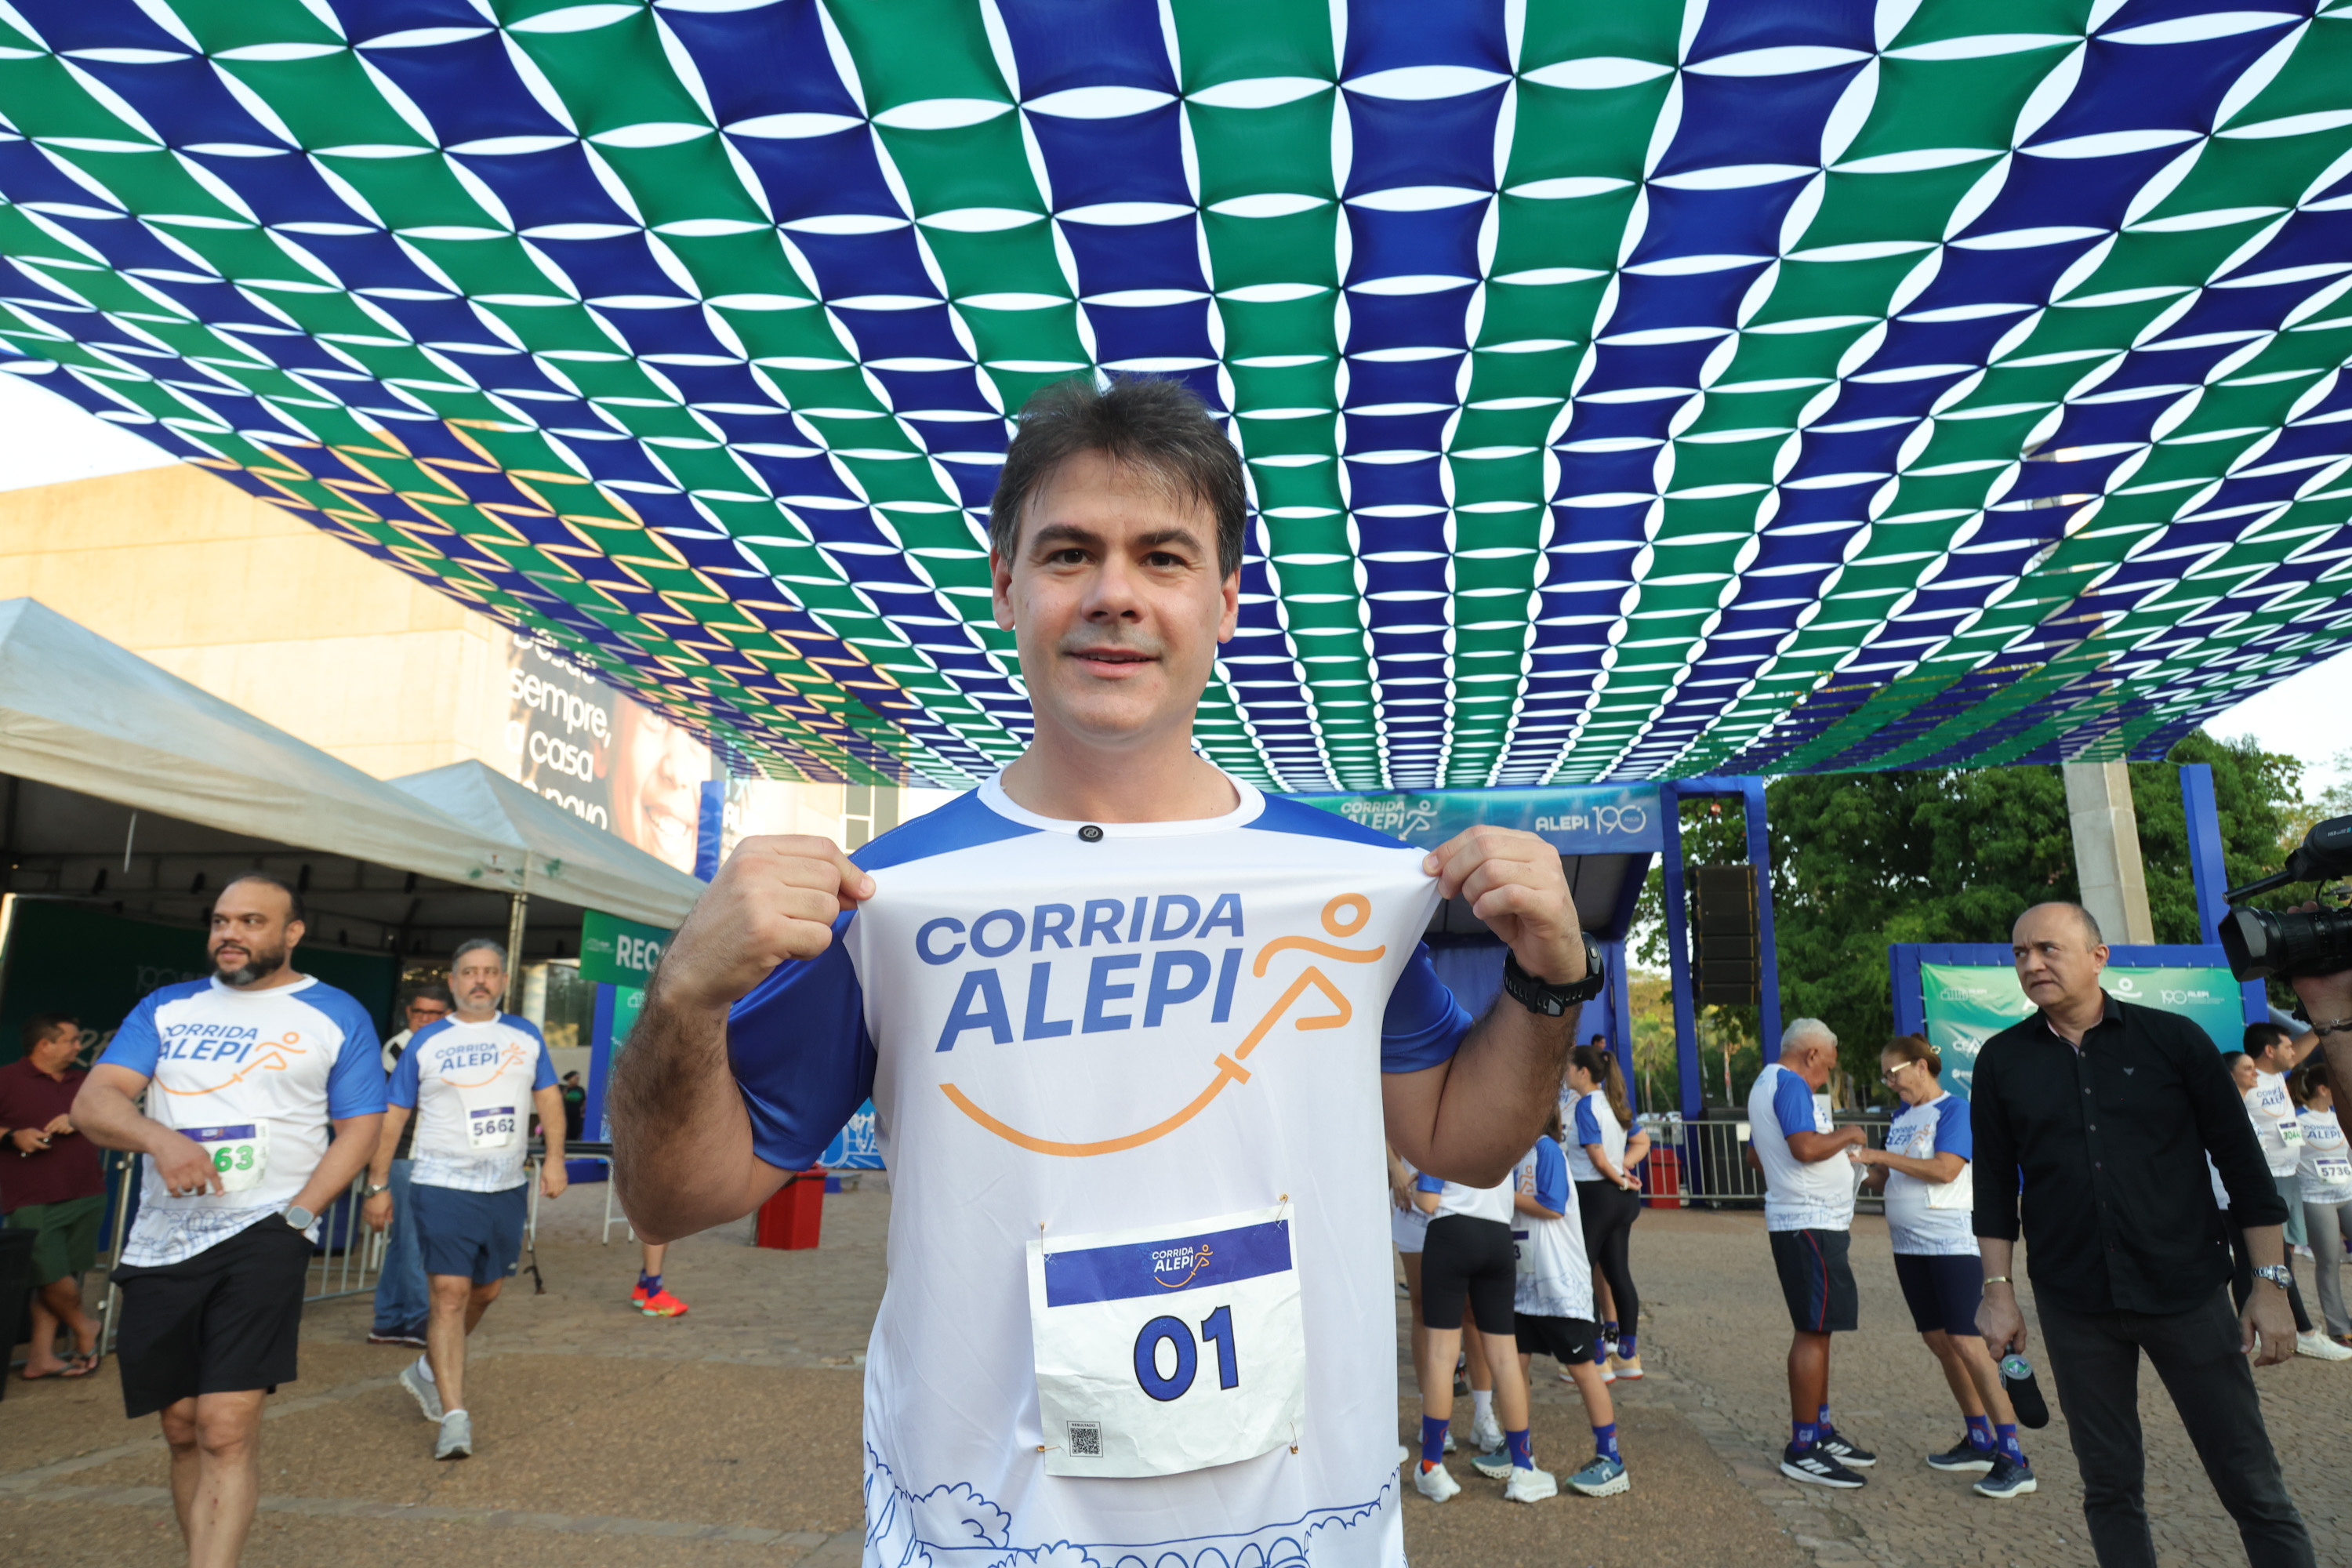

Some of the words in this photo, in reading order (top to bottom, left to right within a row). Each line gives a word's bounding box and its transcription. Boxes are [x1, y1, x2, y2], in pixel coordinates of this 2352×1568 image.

[509, 667, 612, 749] sempre,
[530, 731, 593, 783] casa
[1341, 800, 1406, 814] CORRIDA
[1535, 815, 1589, 831] ALEPI
[1592, 804, 1647, 835] 190
[916, 893, 1244, 965] CORRIDA
[935, 948, 1243, 1053] ALEPI
[166, 1023, 259, 1040] ORRIDA
[435, 1043, 498, 1059] CORRIDA
[440, 1051, 499, 1073] ALEPI
[474, 1118, 515, 1137] 5662
[2307, 1131, 2341, 1139] ALEPI
[213, 1145, 254, 1173] 63
[2321, 1166, 2350, 1177] 5736
[1152, 1247, 1194, 1260] CORRIDA
[1154, 1255, 1194, 1273] ALEPI
[1133, 1305, 1240, 1402] 01
